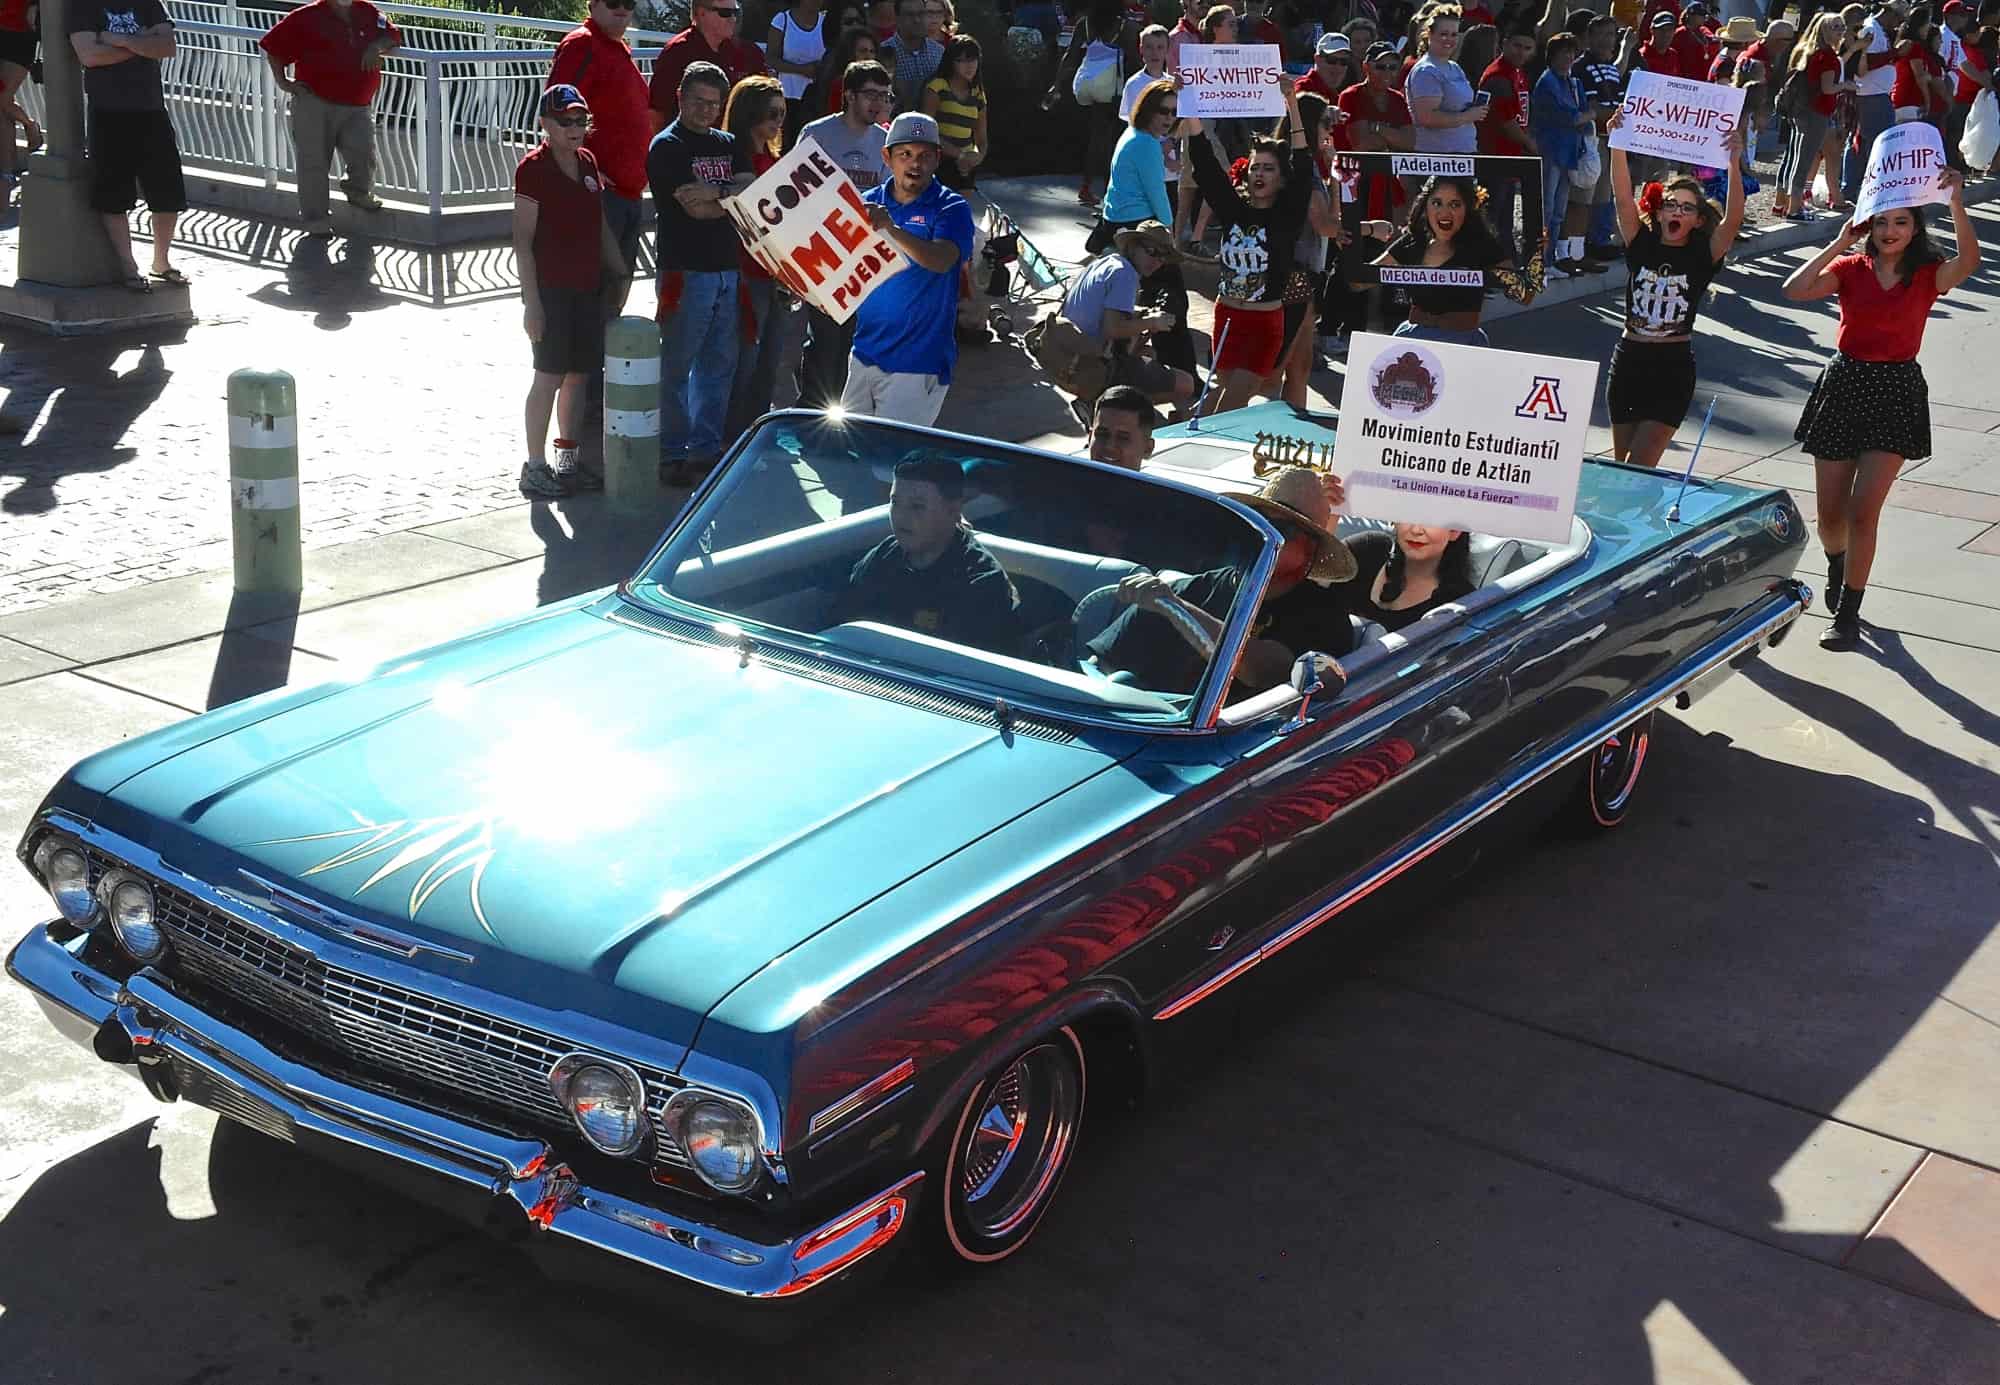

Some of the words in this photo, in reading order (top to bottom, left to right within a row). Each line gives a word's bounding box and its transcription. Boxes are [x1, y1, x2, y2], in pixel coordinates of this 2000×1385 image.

[1394, 157, 1472, 174] ¡Adelante!
[832, 240, 897, 310] PUEDE
[1430, 271, 1446, 283] de
[1449, 272, 1482, 284] UofA
[1515, 375, 1568, 422] A
[1361, 417, 1461, 449] Movimiento
[1381, 447, 1446, 474] Chicano
[1451, 456, 1471, 476] de
[1476, 460, 1532, 484] Aztlán
[1440, 485, 1466, 498] Hace
[1467, 488, 1479, 499] La
